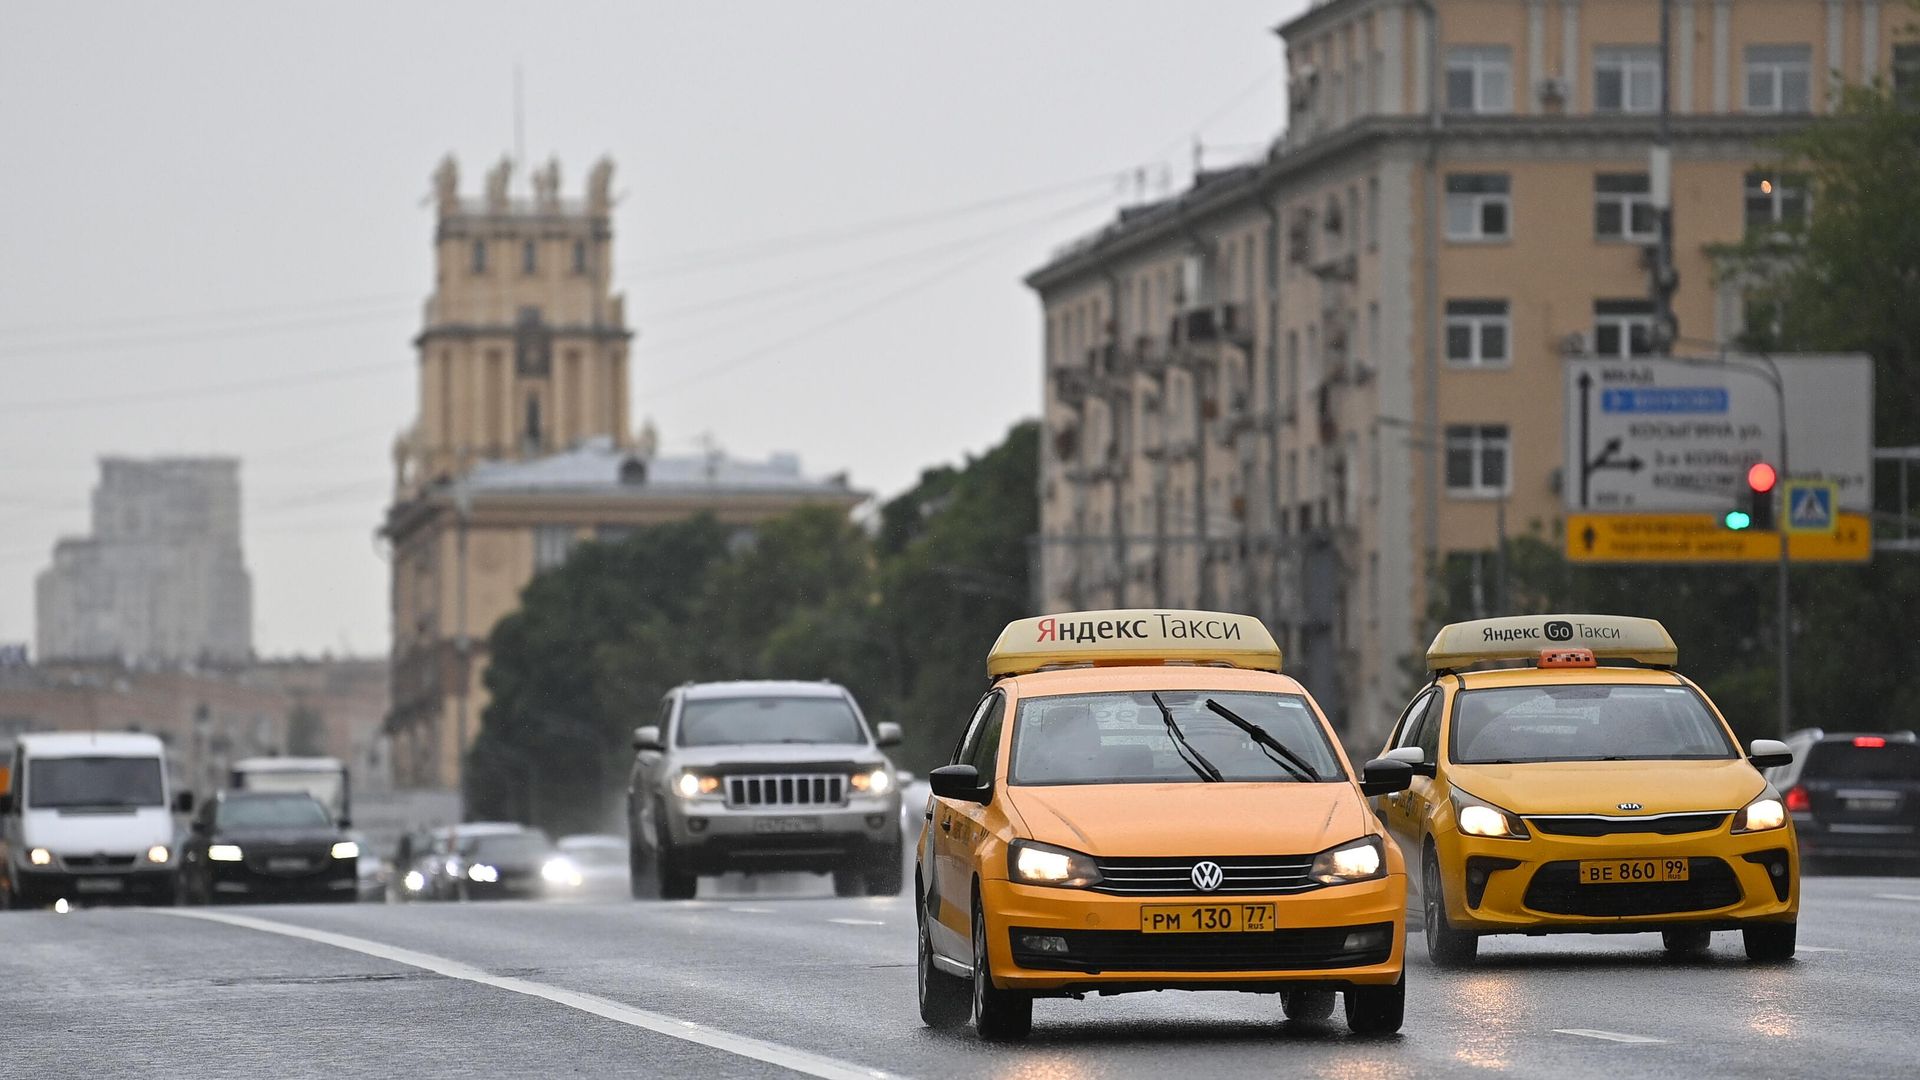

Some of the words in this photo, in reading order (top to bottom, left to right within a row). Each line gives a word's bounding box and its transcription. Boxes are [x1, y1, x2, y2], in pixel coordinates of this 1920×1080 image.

[1036, 618, 1149, 643] Яндекс
[1153, 614, 1241, 640] Такси
[1483, 626, 1540, 641] Яндекс
[1547, 624, 1571, 638] Go
[1576, 623, 1620, 639] Такси
[1619, 862, 1655, 879] 860
[1665, 860, 1683, 874] 99
[1192, 908, 1232, 929] 130
[1245, 907, 1267, 922] 77
